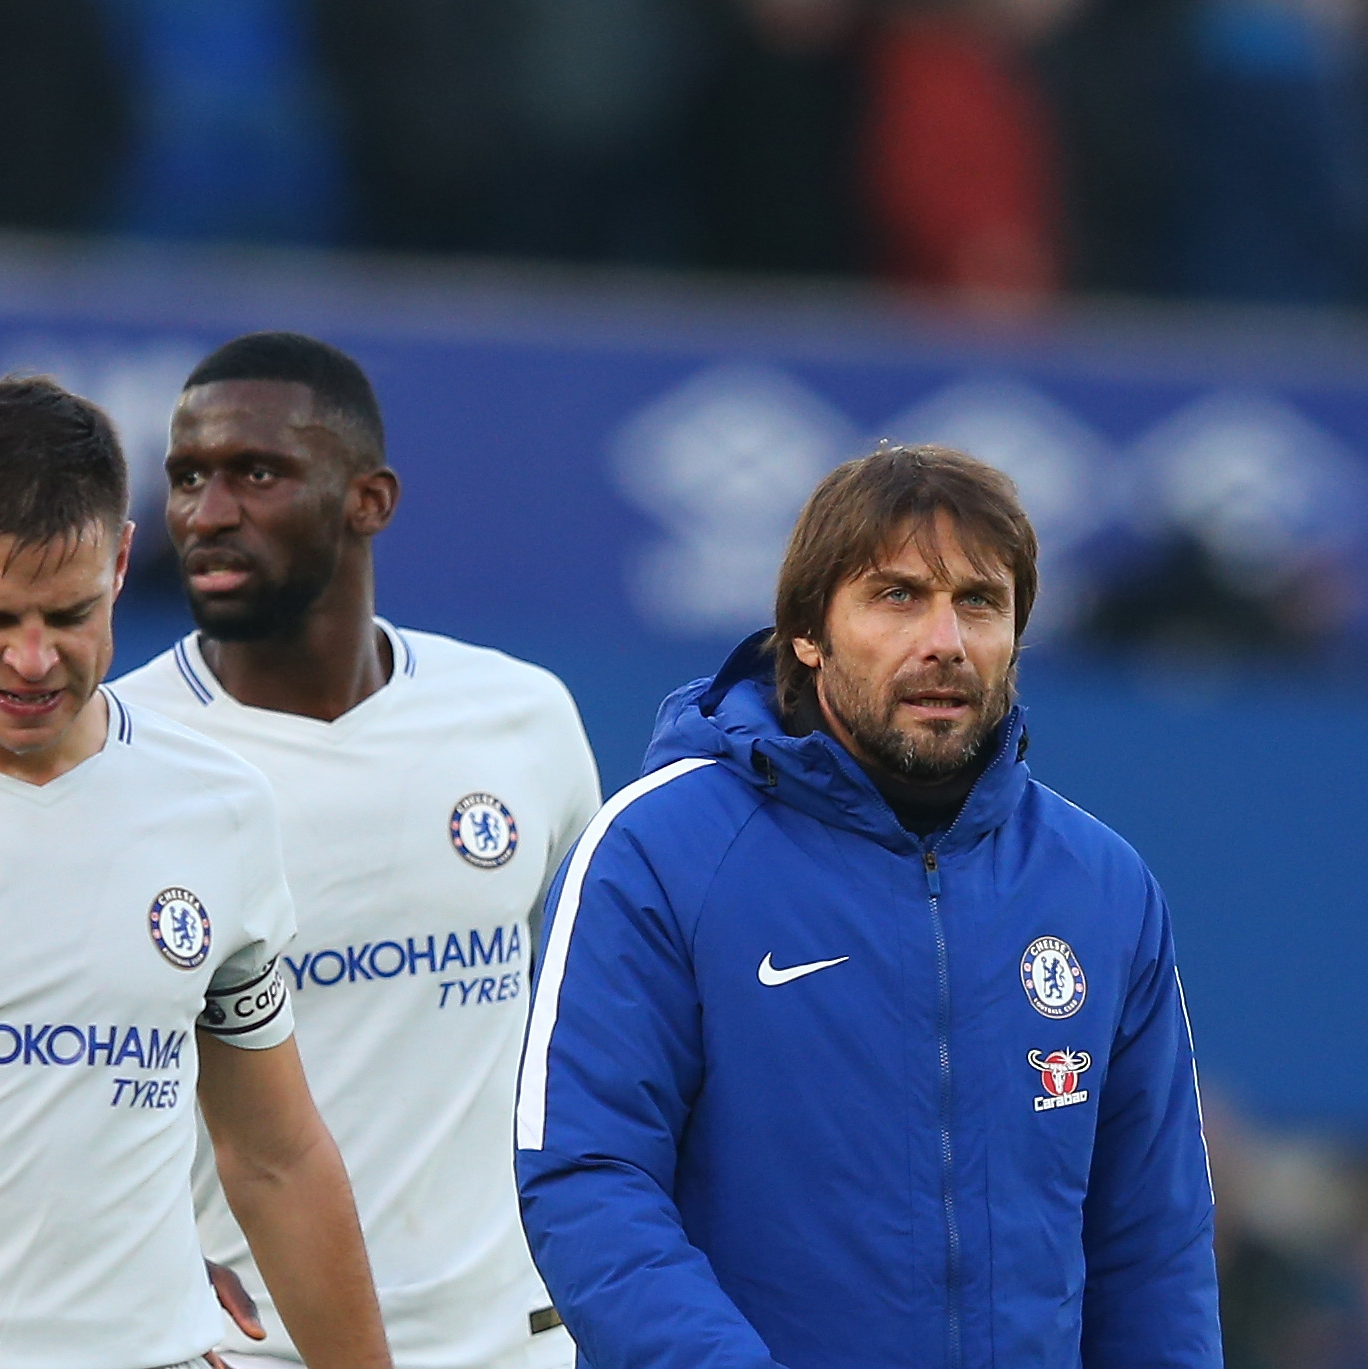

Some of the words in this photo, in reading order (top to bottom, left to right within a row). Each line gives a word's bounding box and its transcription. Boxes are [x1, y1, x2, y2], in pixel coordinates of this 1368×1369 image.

[283, 923, 522, 991] YOKOHAMA
[1030, 939, 1071, 960] CHELSEA
[438, 970, 521, 1010] TYRES
[110, 1078, 180, 1109] TYRES
[1034, 1090, 1088, 1112] Carabao
